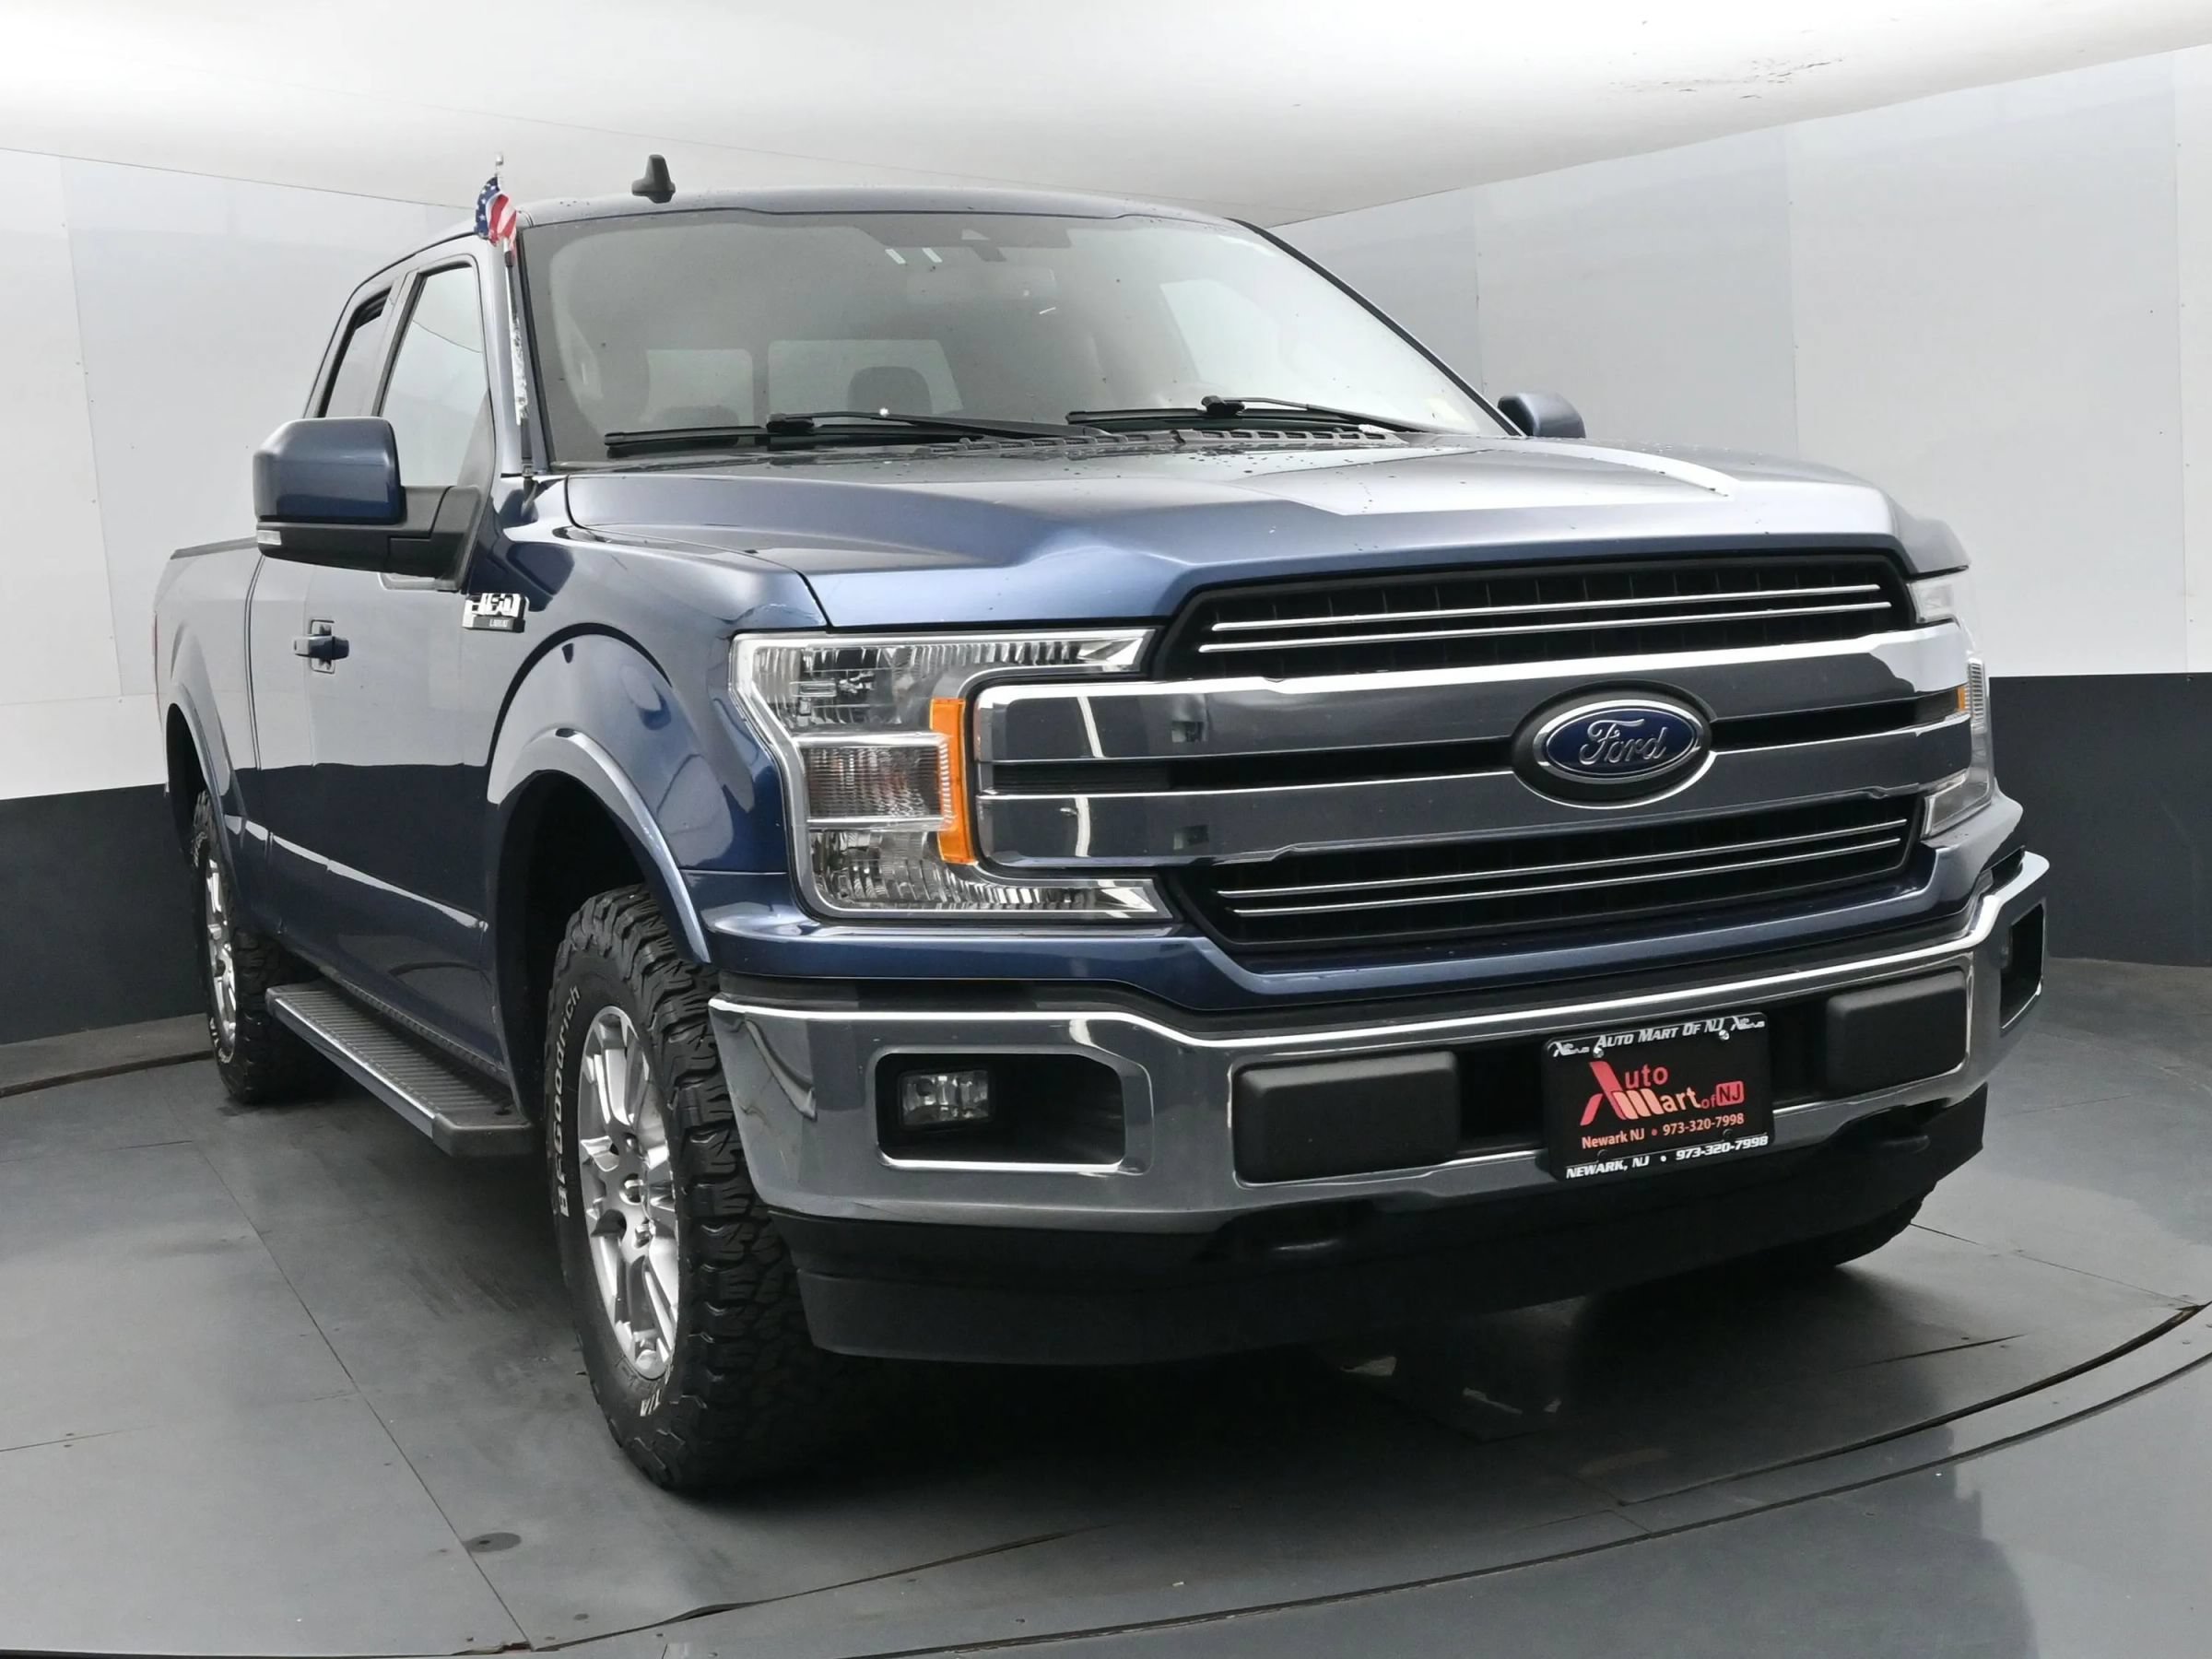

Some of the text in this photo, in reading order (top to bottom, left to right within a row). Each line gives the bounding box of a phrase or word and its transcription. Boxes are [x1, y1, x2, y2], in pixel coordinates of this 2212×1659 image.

[1580, 718, 1667, 765] Ford
[1704, 1017, 1725, 1032] NJ
[1580, 1060, 1668, 1126] Auto
[1613, 1082, 1743, 1120] Mart of NJ
[1582, 1112, 1745, 1149] Newark NJ 973-320-7998
[1566, 1135, 1769, 1179] NEWARK, NJ 973-320-7998
